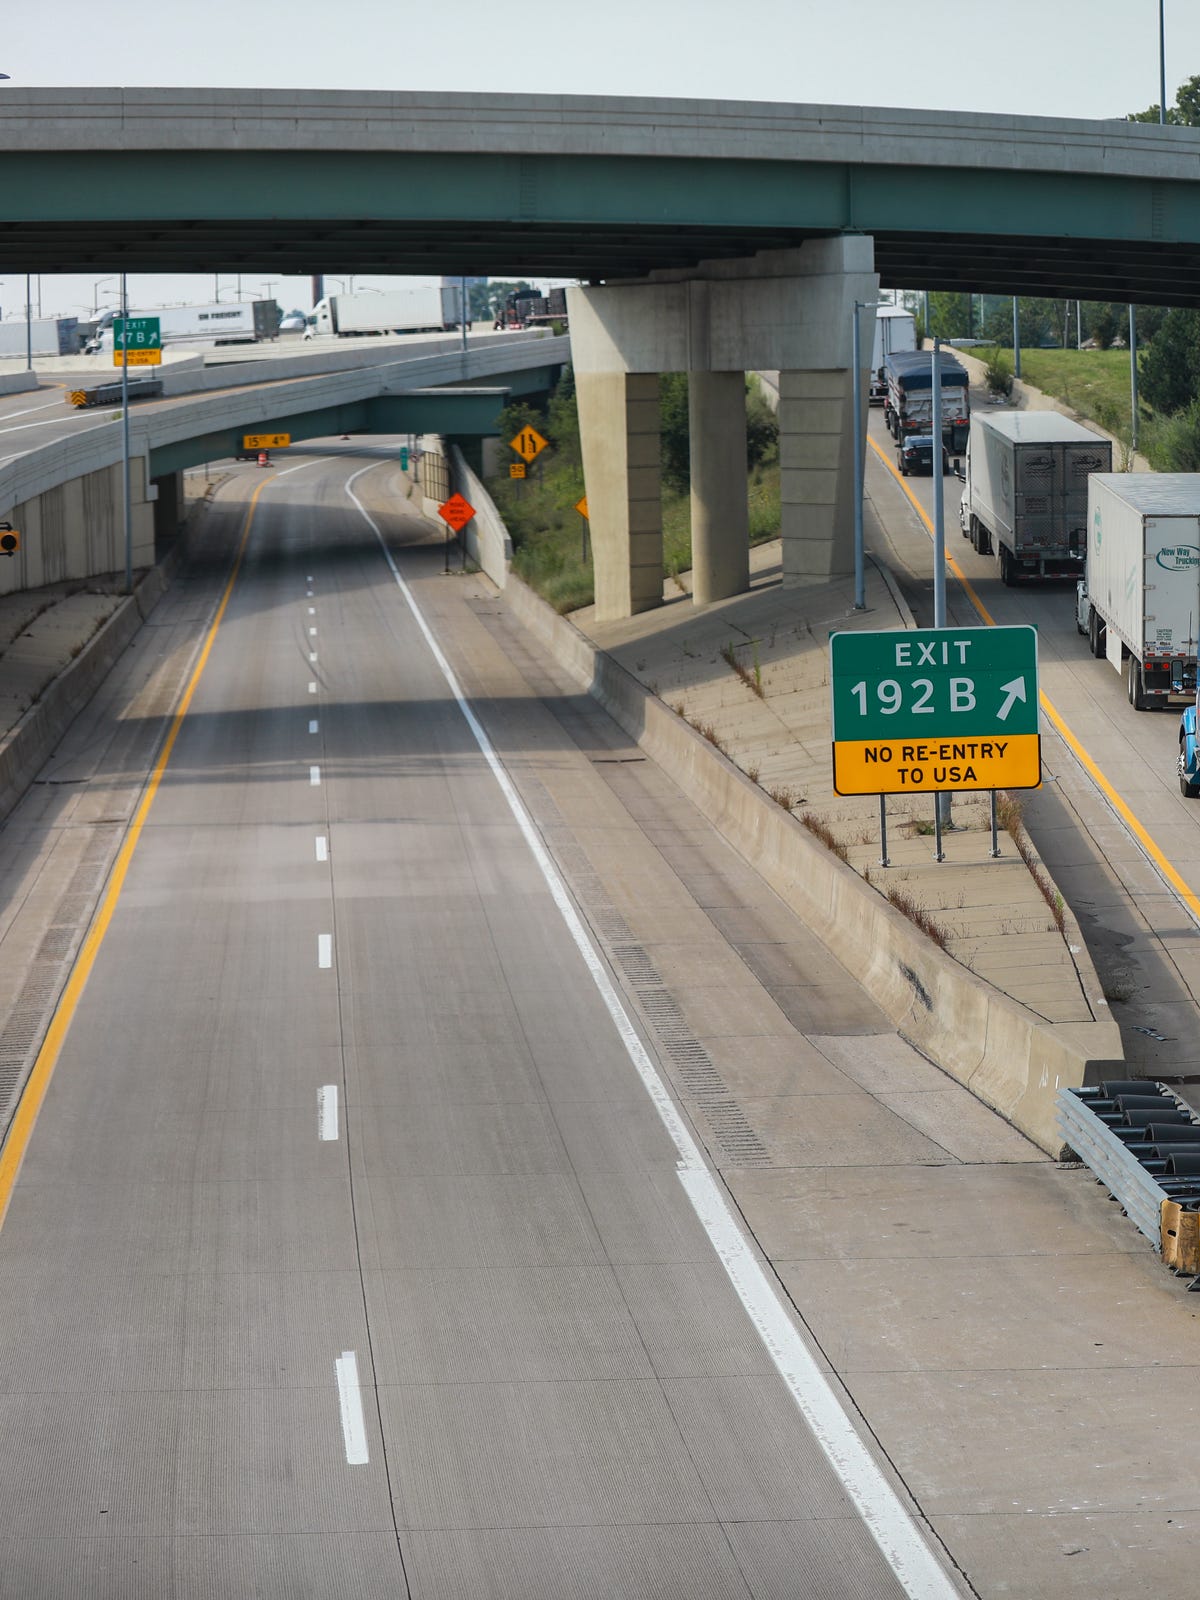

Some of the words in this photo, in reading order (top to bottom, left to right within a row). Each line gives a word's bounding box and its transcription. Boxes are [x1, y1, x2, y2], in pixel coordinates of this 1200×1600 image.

[126, 321, 147, 329] EXIT
[137, 332, 145, 343] B
[1161, 548, 1175, 556] New
[1177, 547, 1190, 556] Way
[1175, 556, 1200, 566] Trucking
[895, 640, 972, 666] EXIT
[850, 678, 935, 716] 192
[949, 677, 977, 712] B
[864, 746, 893, 763] NO
[902, 742, 1008, 761] RE-ENTRY
[897, 768, 924, 784] TO
[933, 766, 977, 783] USA
